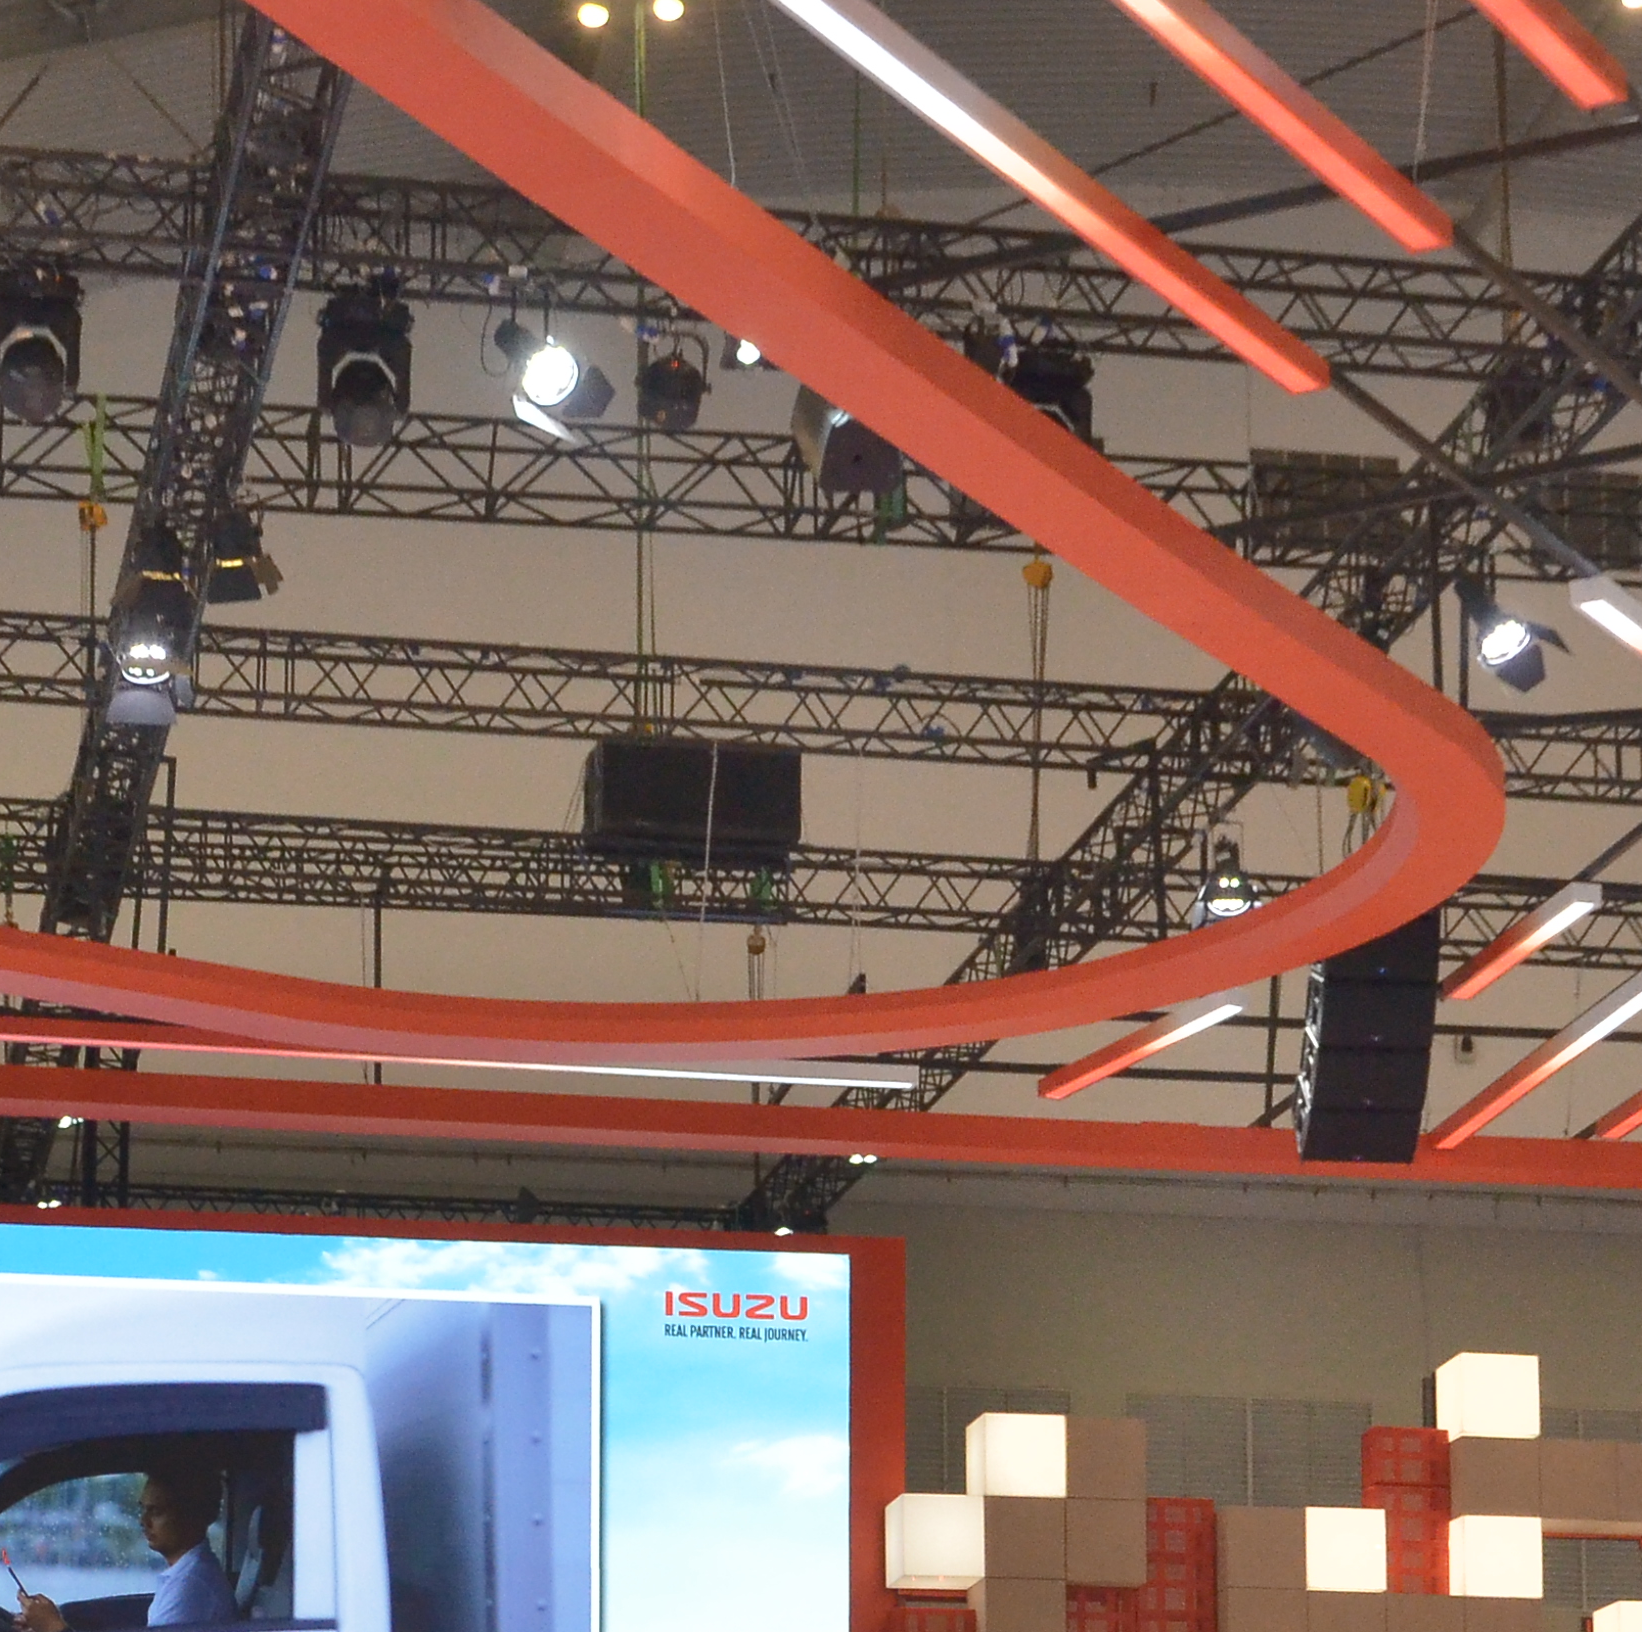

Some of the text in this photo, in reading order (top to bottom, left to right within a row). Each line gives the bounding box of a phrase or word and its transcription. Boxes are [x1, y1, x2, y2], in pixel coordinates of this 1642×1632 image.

[665, 1291, 809, 1321] ISUZU
[664, 1324, 809, 1343] REAL PARTNER. REAL JOURNEY.
